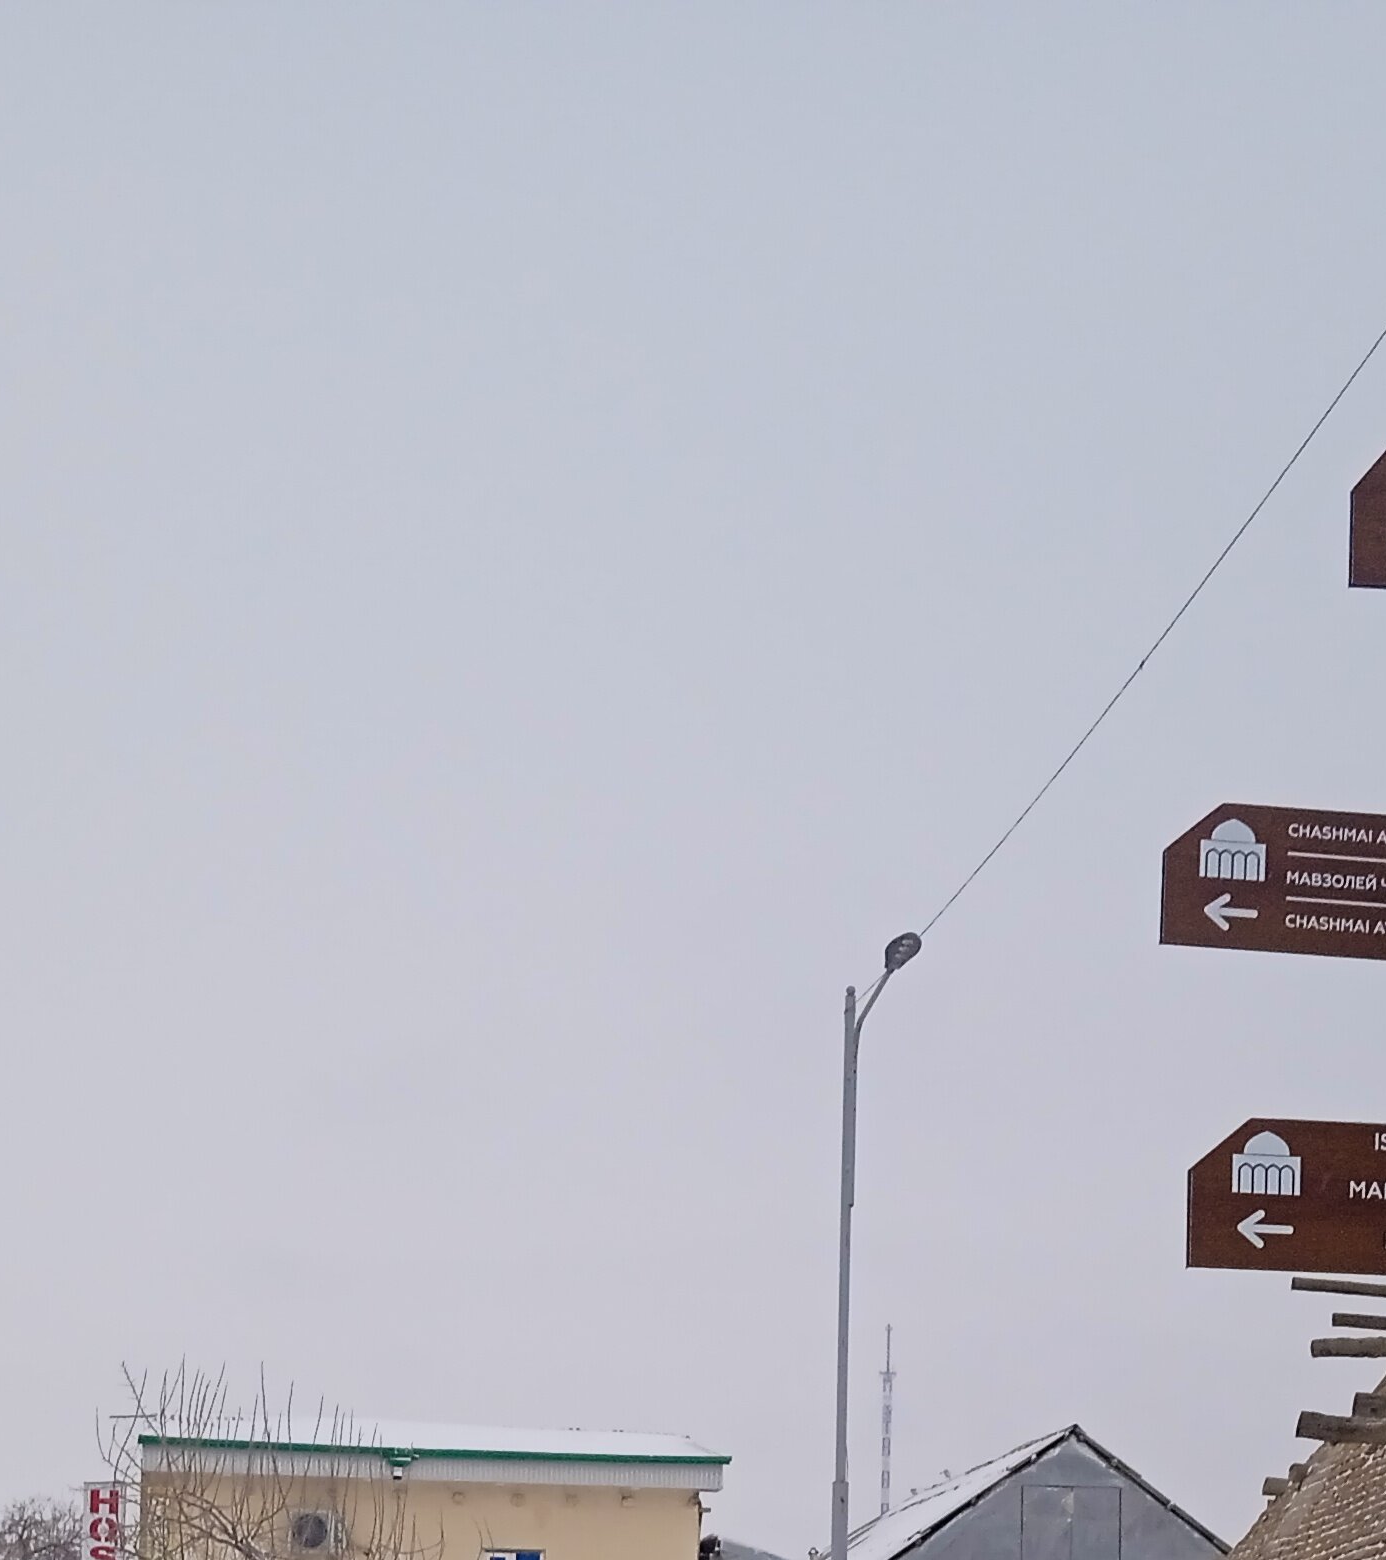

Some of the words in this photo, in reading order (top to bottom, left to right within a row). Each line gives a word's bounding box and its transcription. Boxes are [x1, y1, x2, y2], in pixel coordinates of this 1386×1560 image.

[1288, 823, 1373, 843] CHASHMAI
[1286, 871, 1377, 891] МАВЗОЛЕЙ
[1285, 914, 1369, 934] CHASHMAI
